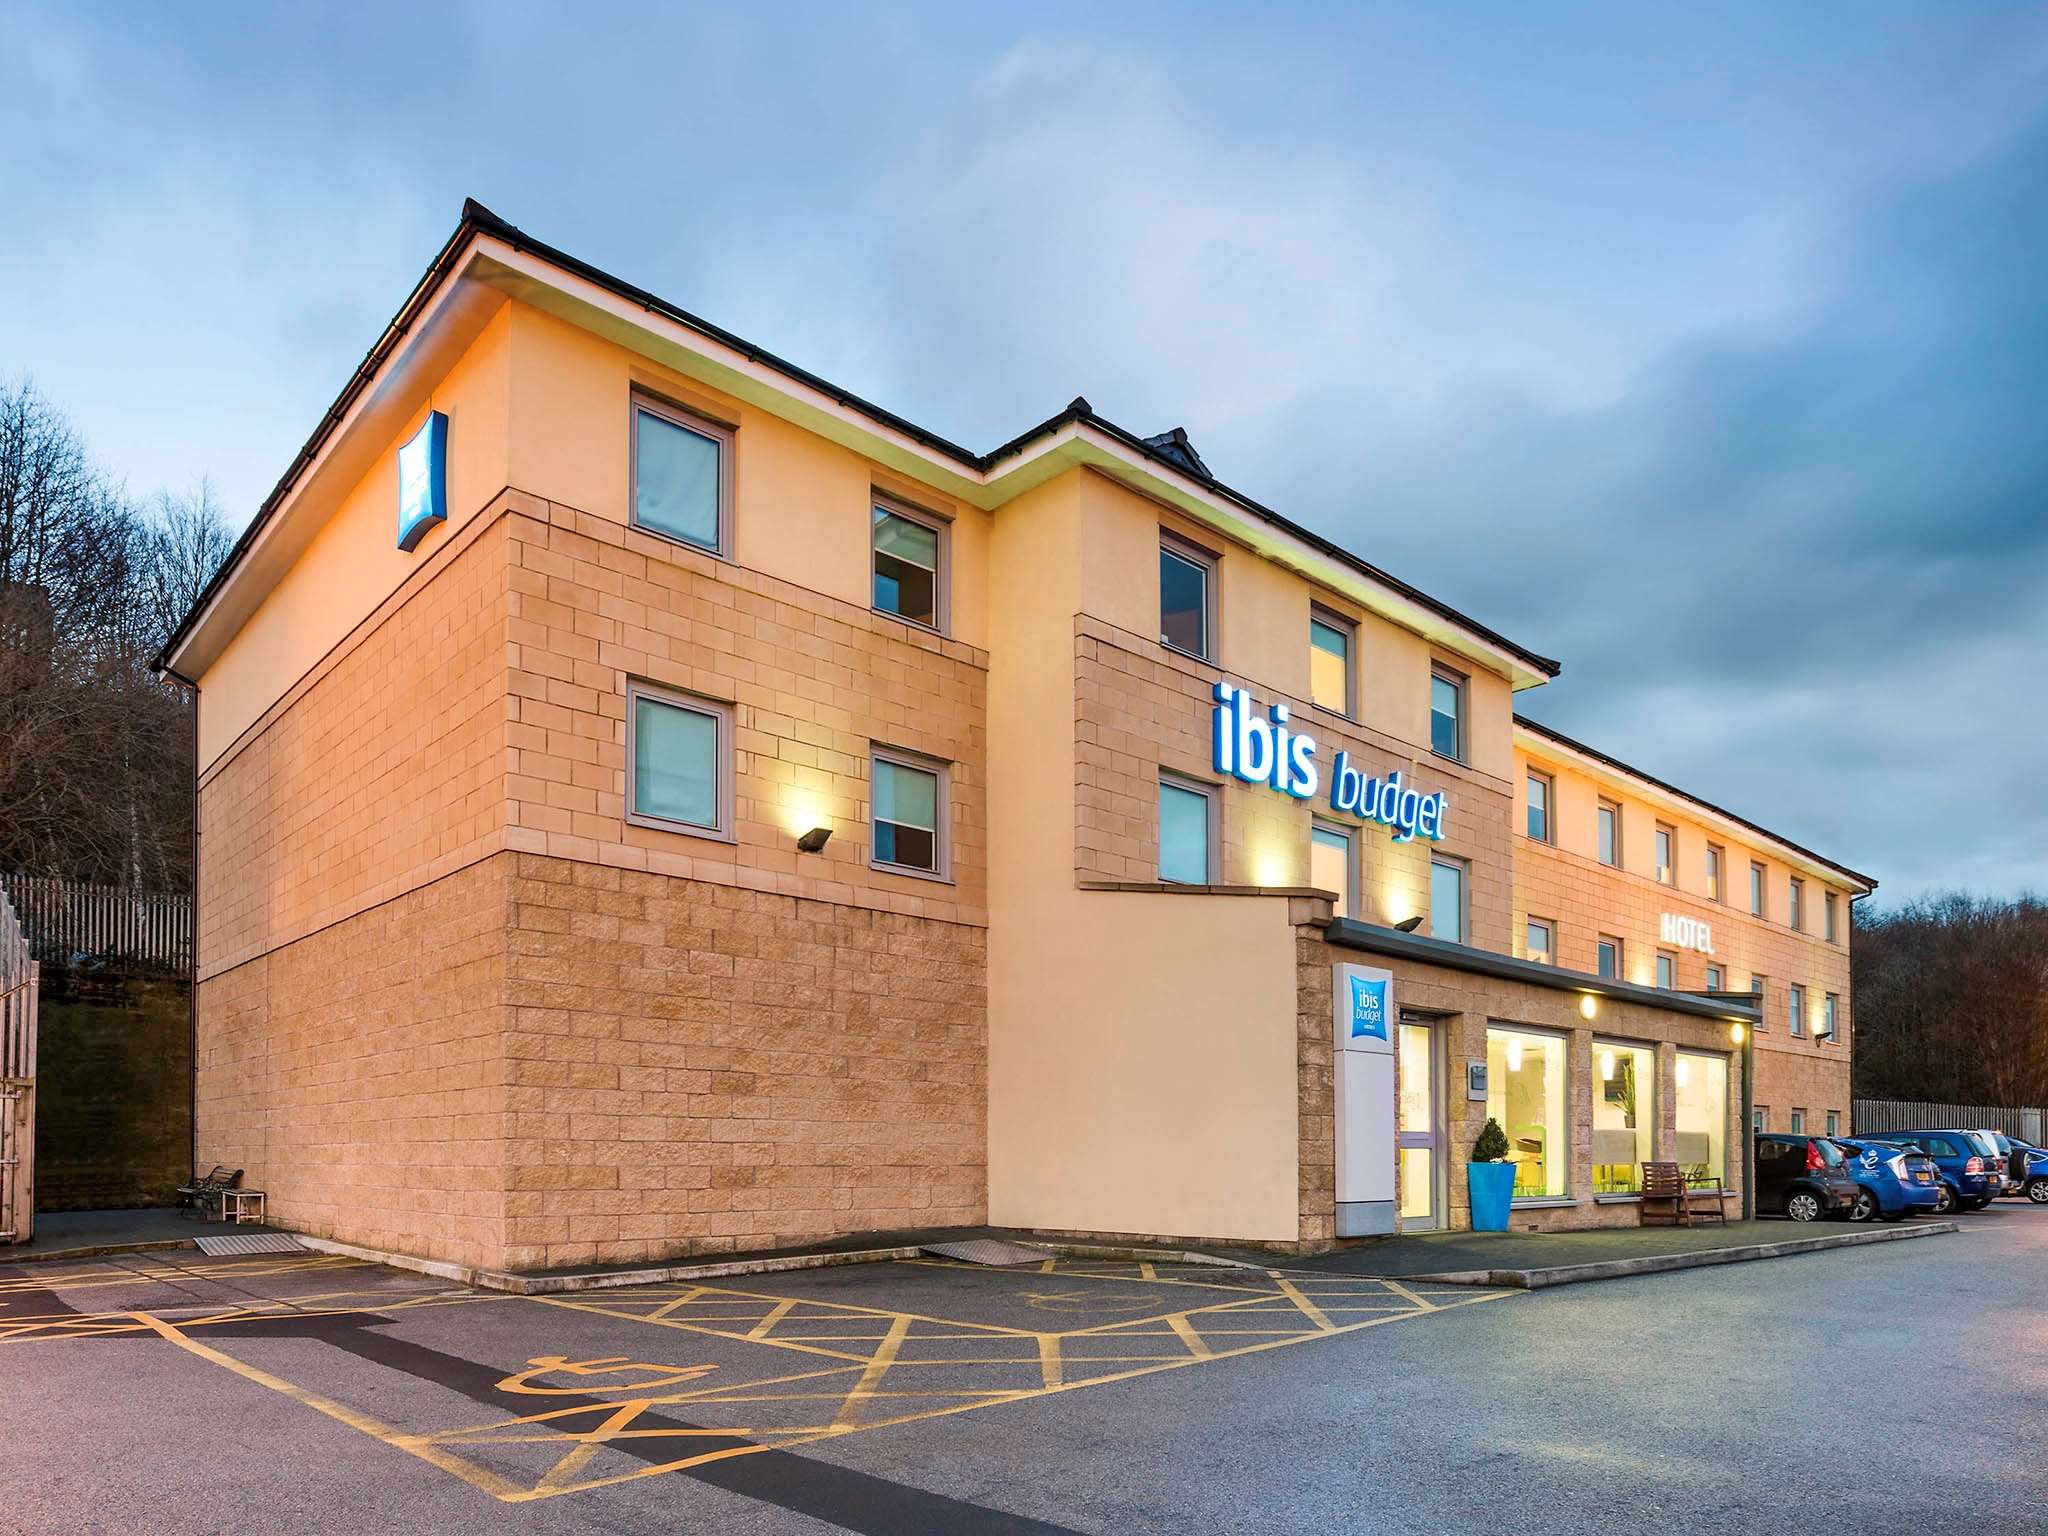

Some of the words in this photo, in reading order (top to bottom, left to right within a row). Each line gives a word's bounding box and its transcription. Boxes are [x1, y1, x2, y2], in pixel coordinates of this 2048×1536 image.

[1213, 682, 1318, 799] ibis
[1331, 751, 1448, 842] budget
[1659, 912, 1715, 955] HOTEL
[1359, 988, 1379, 1009] ibis
[1356, 1006, 1382, 1024] budget
